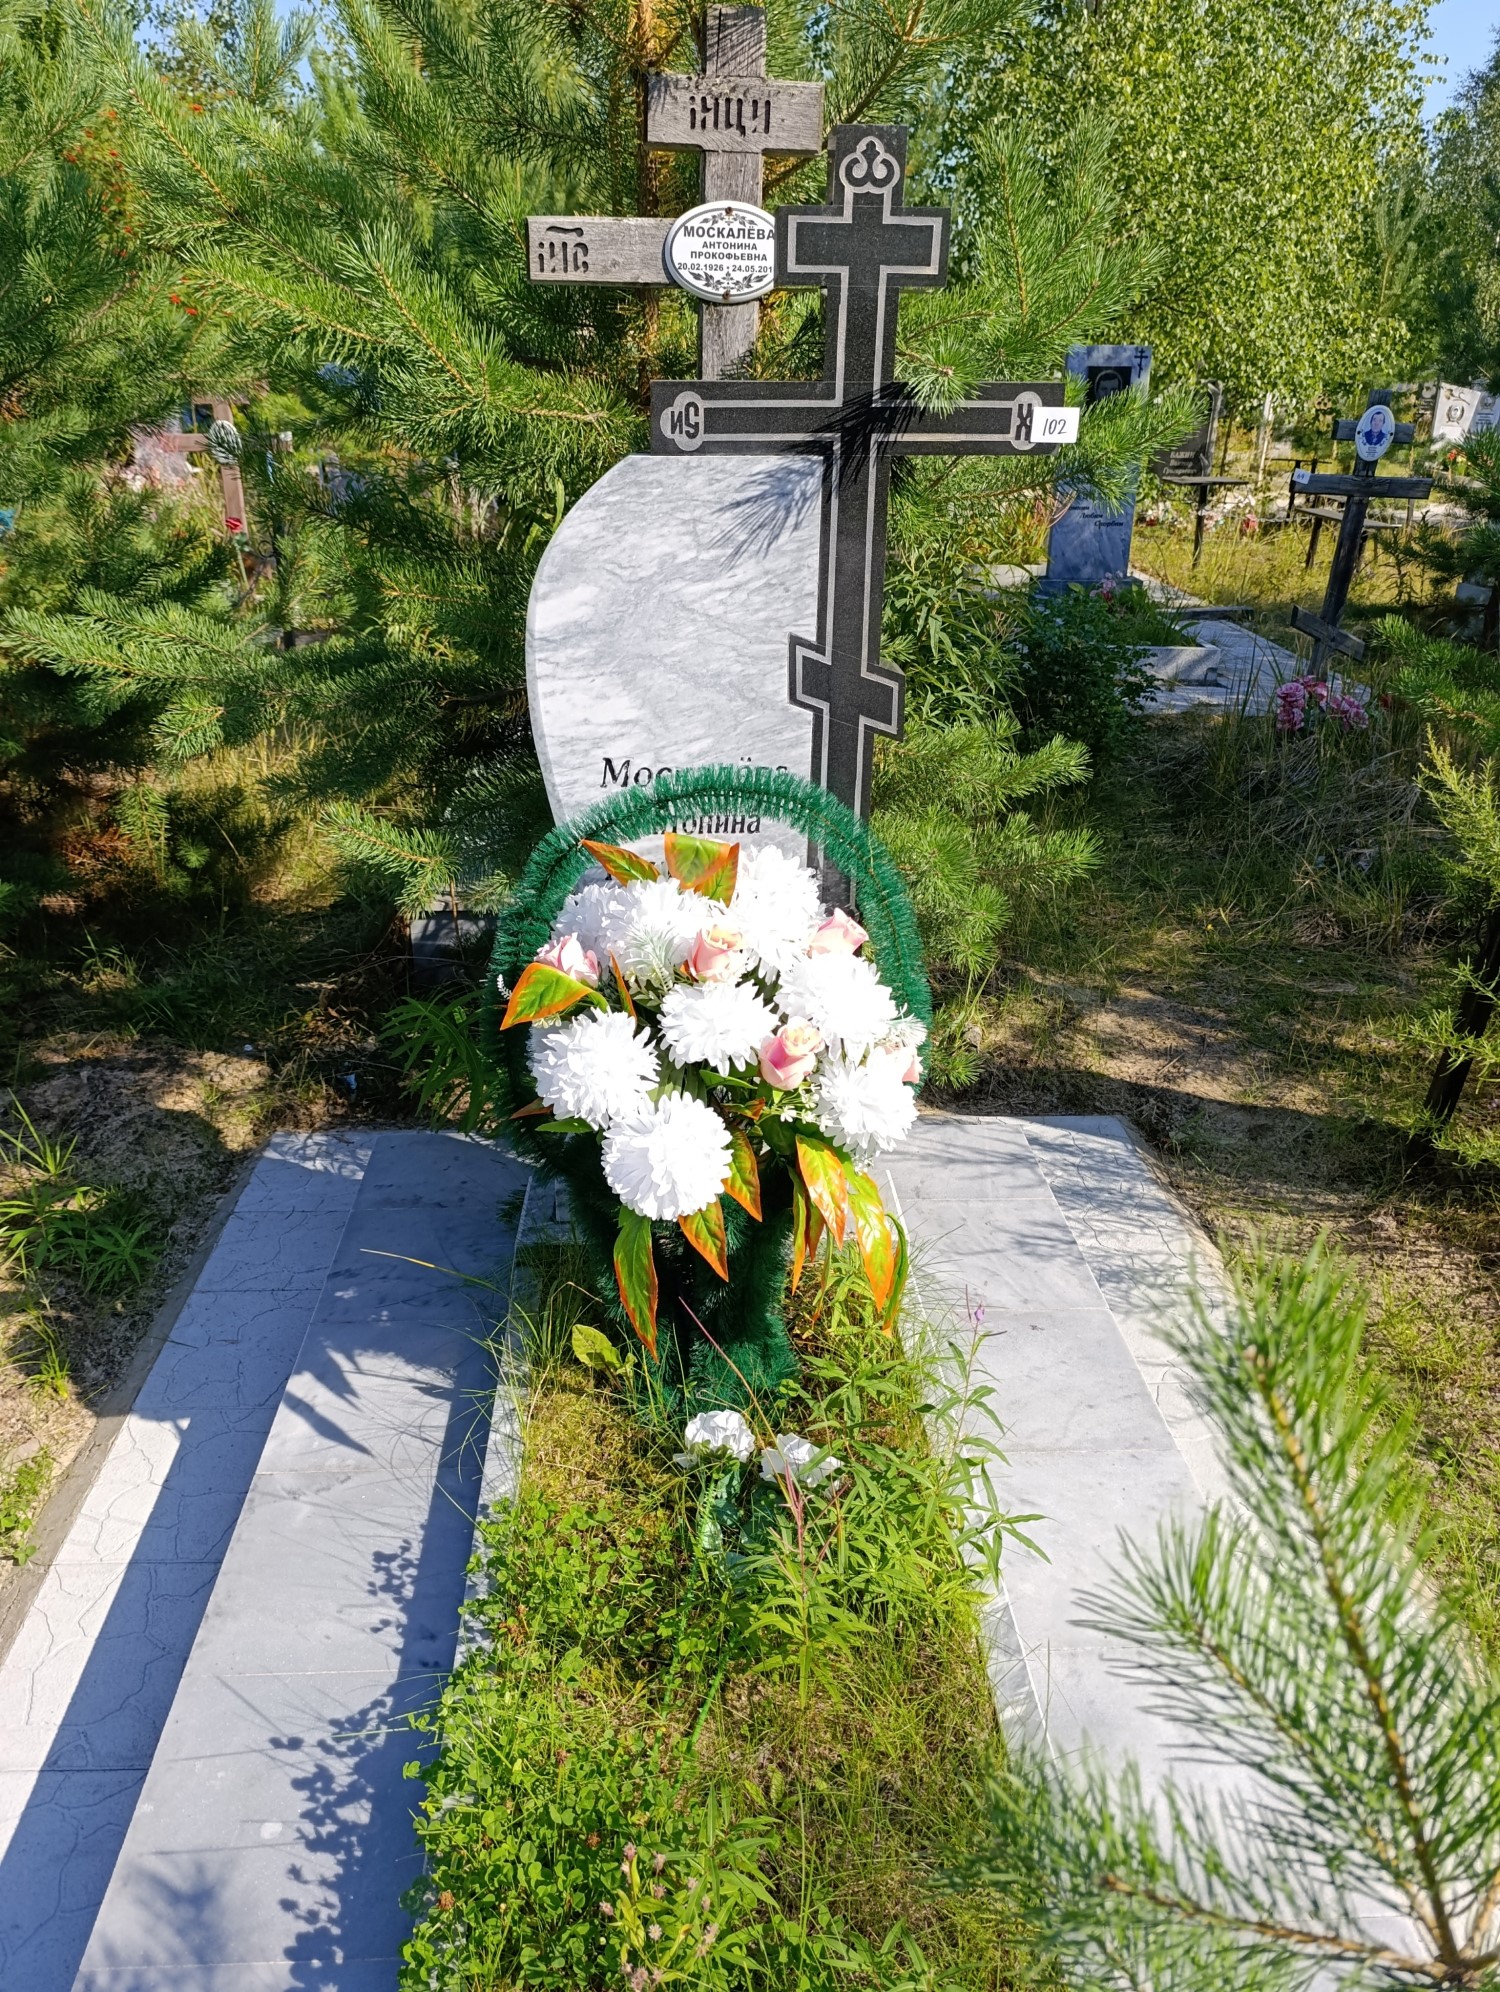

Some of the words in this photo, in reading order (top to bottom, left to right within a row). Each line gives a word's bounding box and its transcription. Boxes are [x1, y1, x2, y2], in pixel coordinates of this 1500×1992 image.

[683, 225, 775, 240] МОСКАЛЁВА
[702, 241, 758, 251] АНТОНИНА
[690, 251, 768, 261] ПРОКОФЬЕВНА
[677, 262, 724, 272] 20.02.1926
[732, 264, 773, 273] 24.05.201
[1042, 418, 1067, 437] 102
